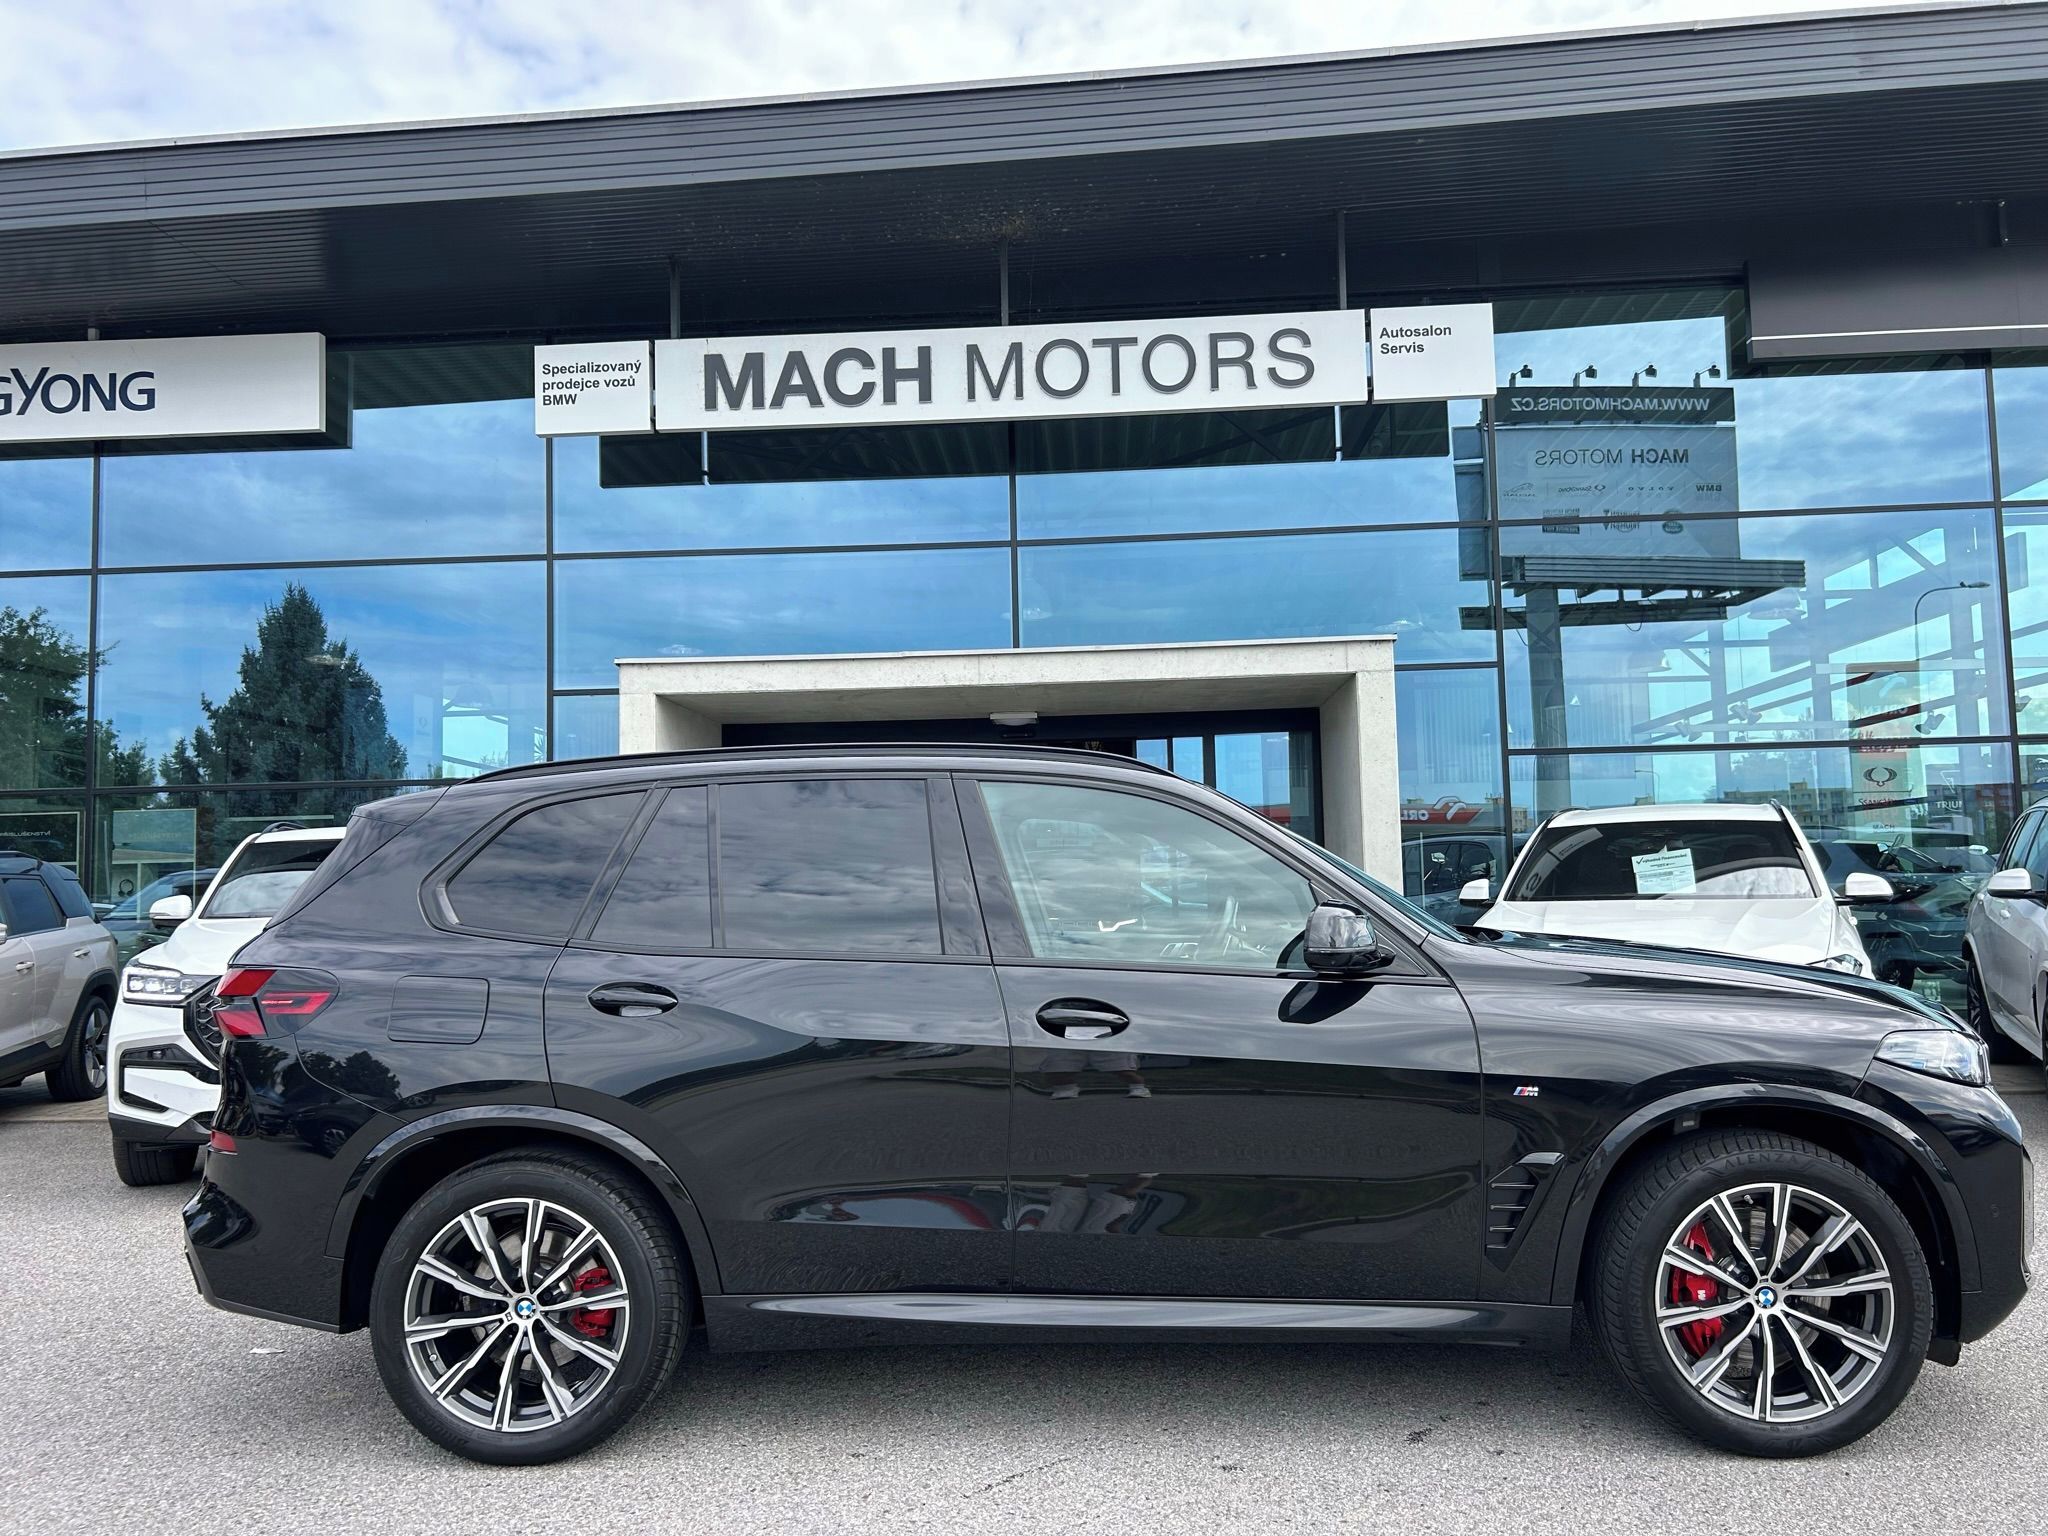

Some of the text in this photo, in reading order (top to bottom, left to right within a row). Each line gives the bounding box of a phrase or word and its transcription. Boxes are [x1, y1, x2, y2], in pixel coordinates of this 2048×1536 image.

[1380, 324, 1452, 339] Autosalon
[1380, 341, 1425, 355] Servis
[541, 359, 642, 376] Specializovaný
[704, 328, 1315, 411] MACH MOTORS
[542, 375, 636, 392] prodejce vozů
[542, 393, 578, 406] BMW
